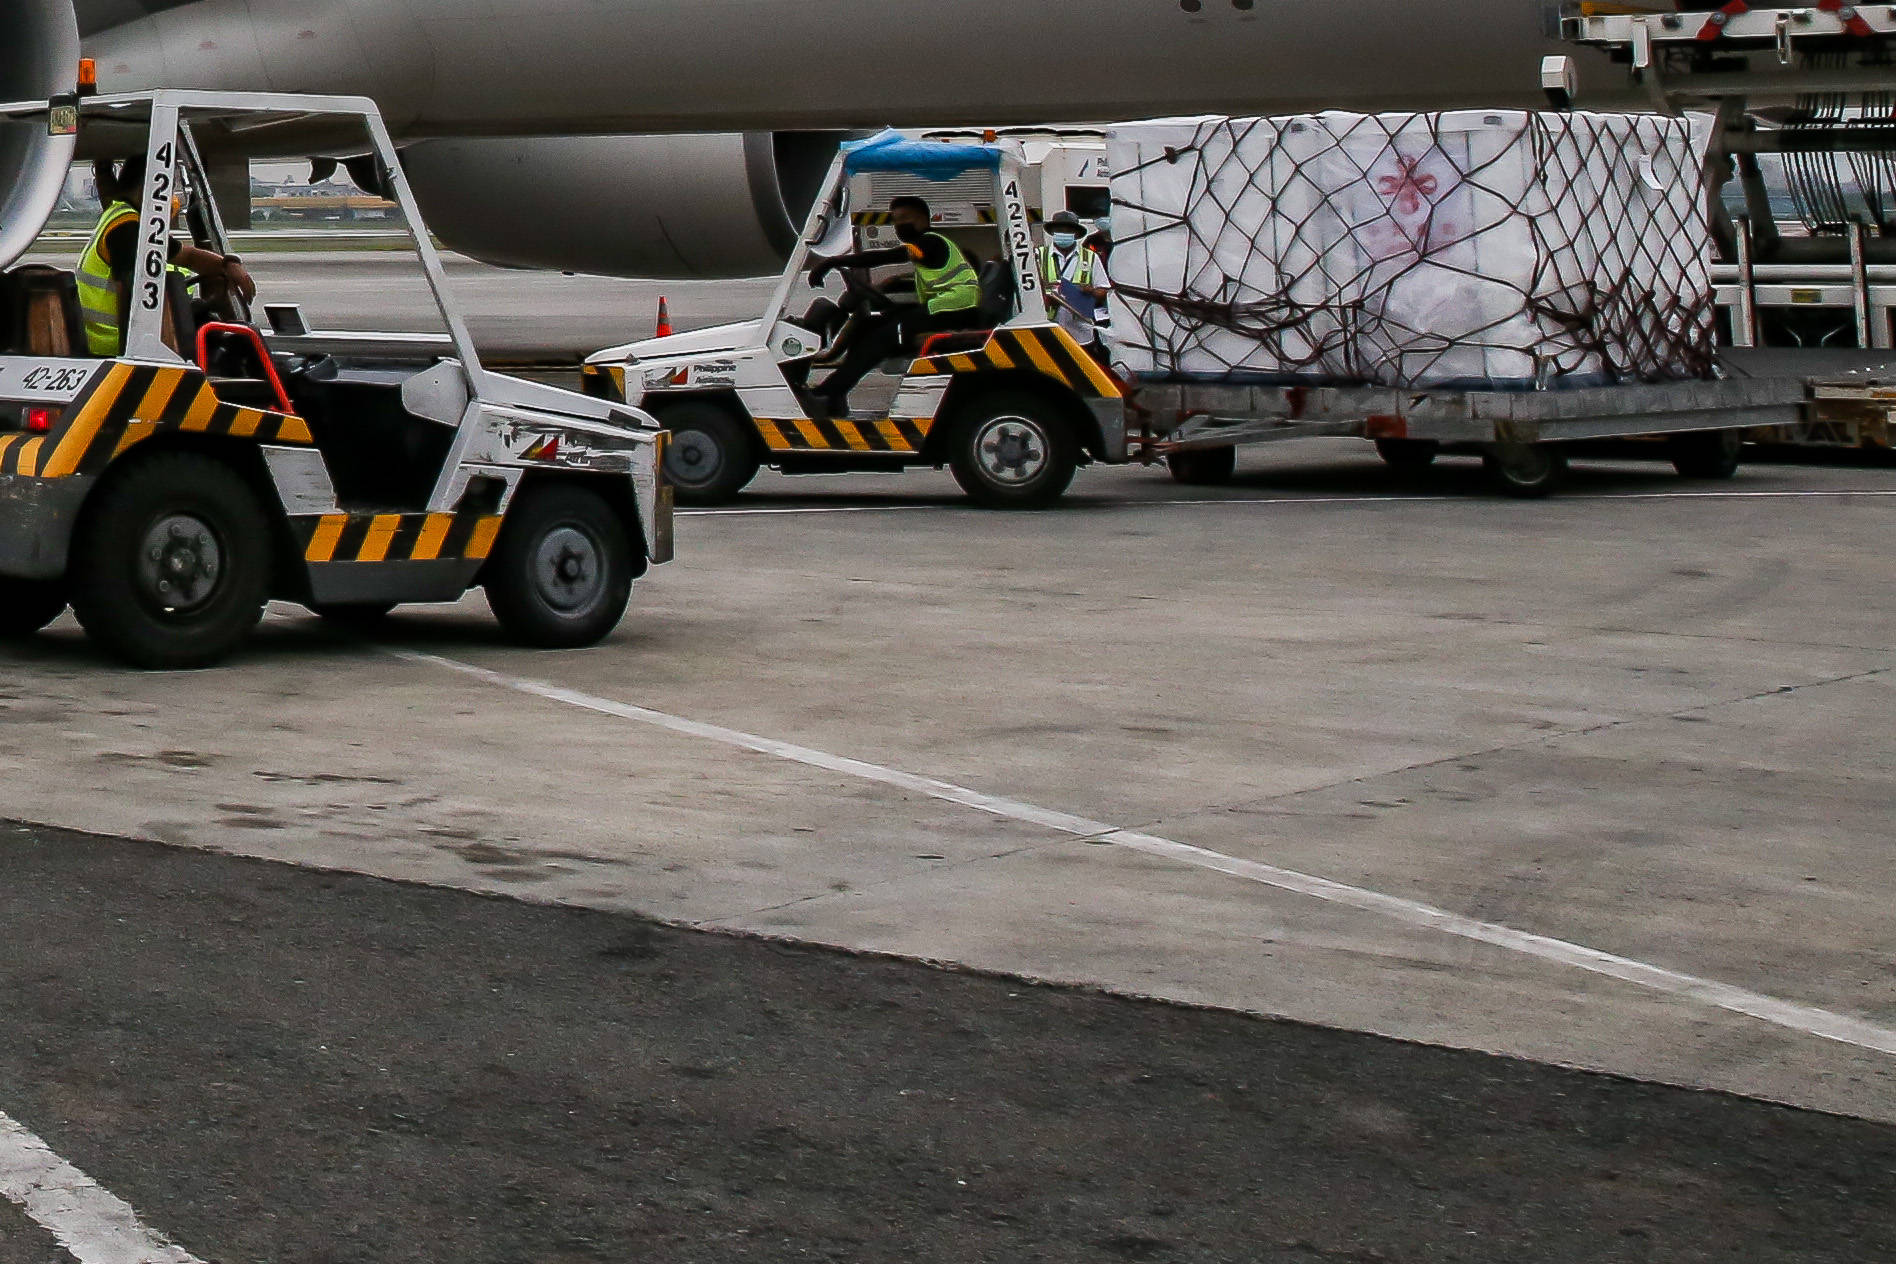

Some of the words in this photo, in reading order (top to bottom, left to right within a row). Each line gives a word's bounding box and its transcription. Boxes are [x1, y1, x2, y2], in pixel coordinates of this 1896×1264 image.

[141, 141, 172, 310] 42-263
[1004, 180, 1035, 291] 42-275
[22, 366, 87, 391] 42-263
